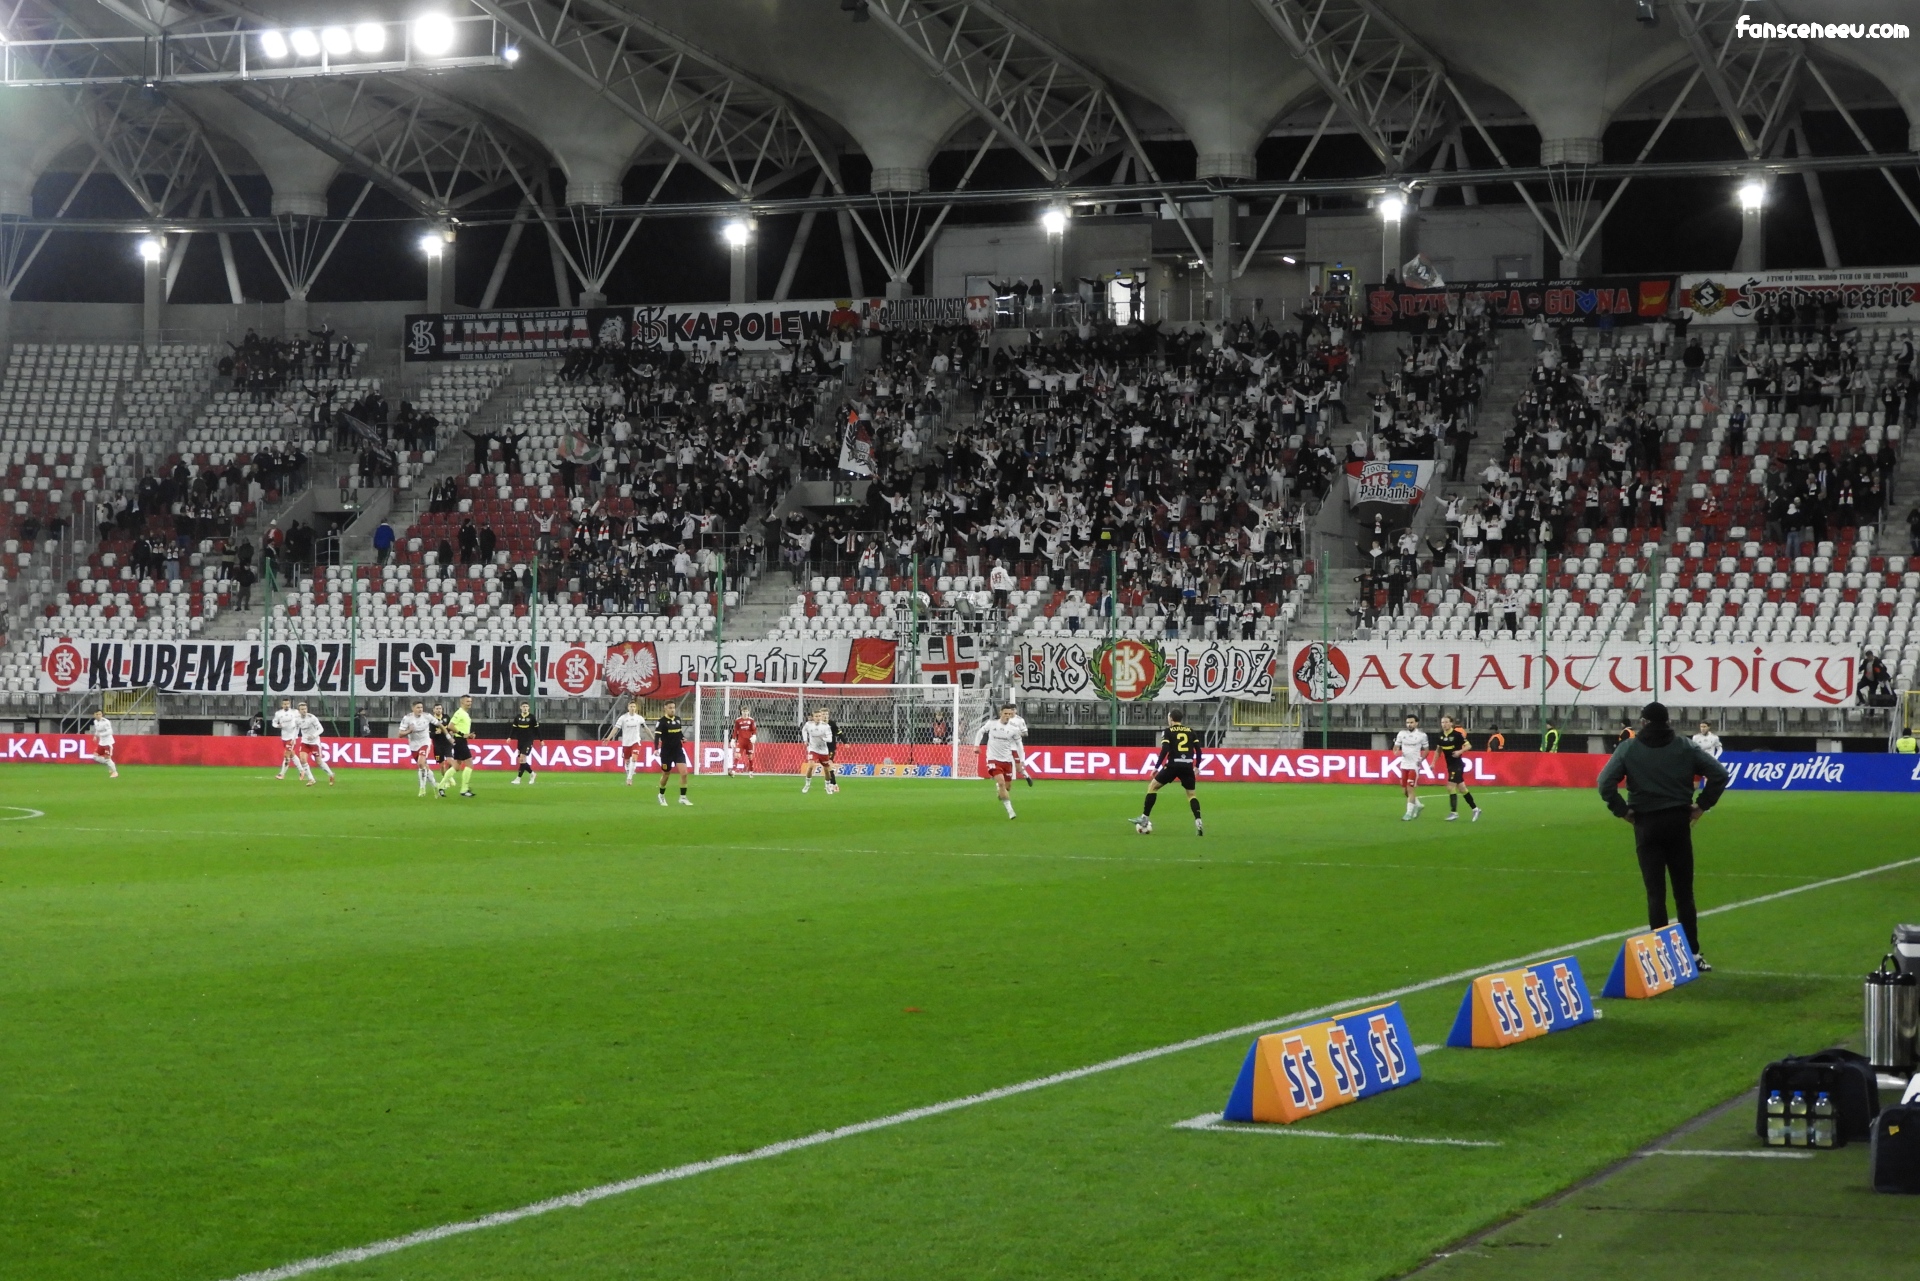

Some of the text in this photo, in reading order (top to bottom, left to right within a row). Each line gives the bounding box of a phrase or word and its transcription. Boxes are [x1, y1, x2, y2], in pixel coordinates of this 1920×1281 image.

[443, 317, 592, 353] LIMANKA
[668, 310, 830, 342] KAROLEW
[88, 643, 235, 692] KLUBEM
[246, 643, 352, 693] ŁODZI
[365, 642, 456, 693] JEST
[468, 645, 550, 695] ŁKS!
[678, 646, 828, 688] ŁKS ŁÓDŹ
[1015, 642, 1090, 695] ŁKS
[1170, 642, 1276, 696] ŁÓDŹ
[0, 738, 94, 759] KA.PL
[1176, 732, 1189, 752] 2
[1744, 762, 1786, 783] nas
[1782, 756, 1845, 790] piłka
